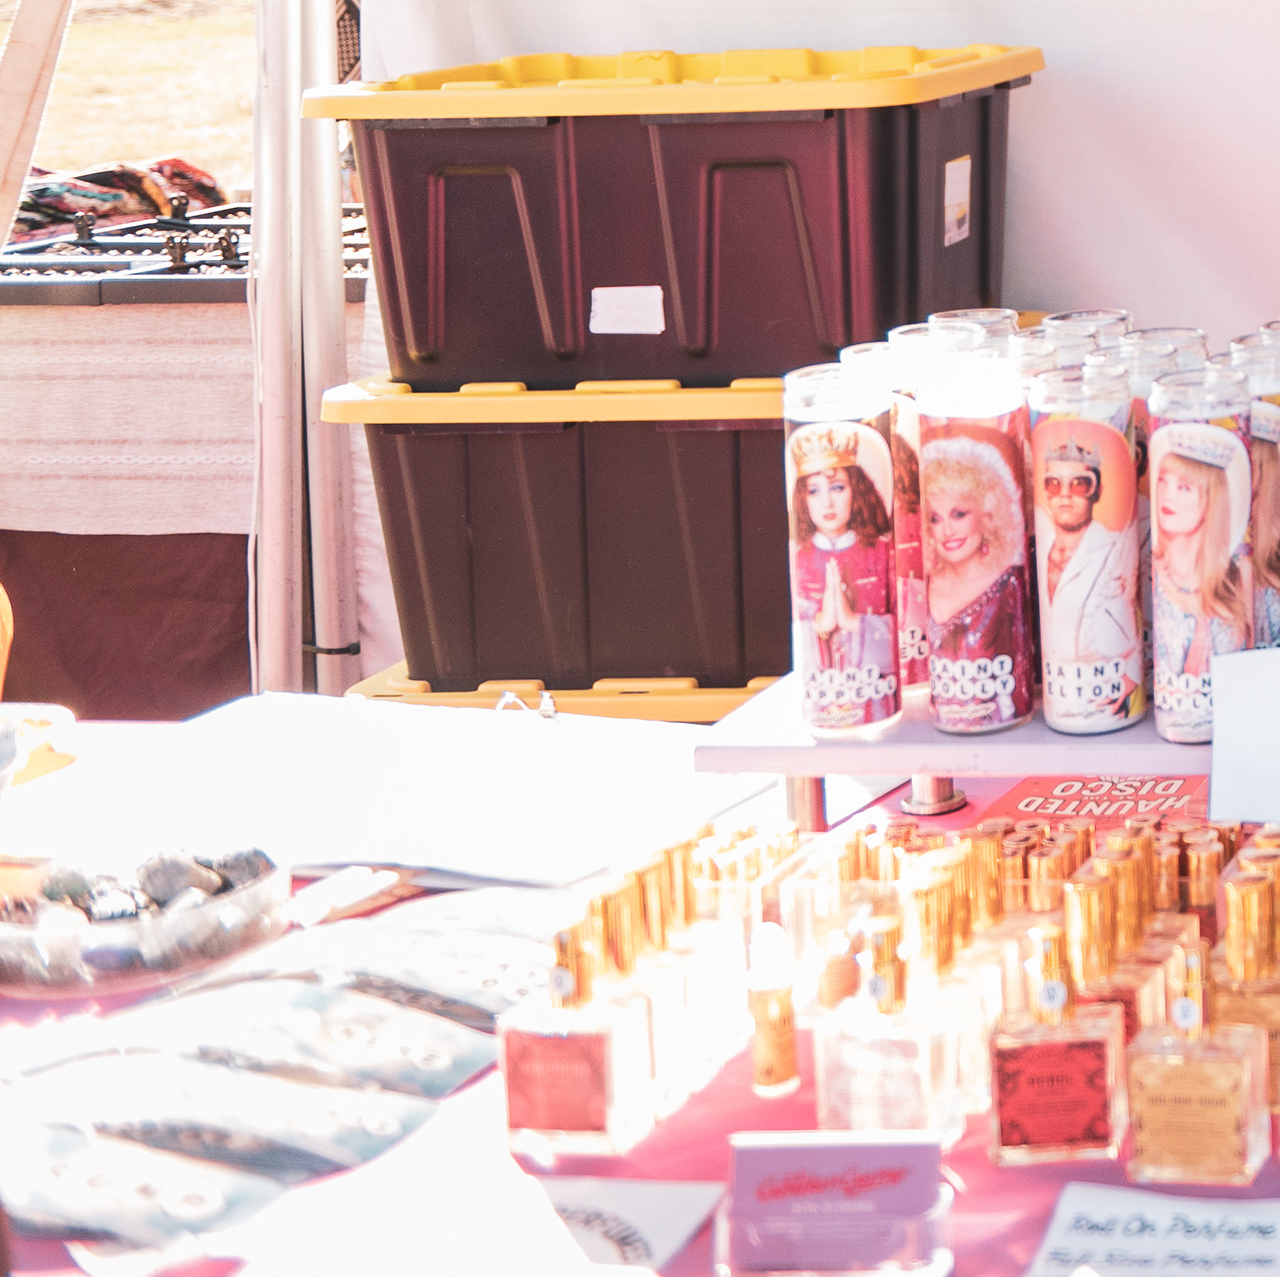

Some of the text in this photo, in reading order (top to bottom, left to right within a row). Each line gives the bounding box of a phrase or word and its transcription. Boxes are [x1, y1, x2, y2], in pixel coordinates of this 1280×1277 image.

[930, 658, 1007, 674] SAINT
[1045, 662, 1121, 678] SAINT
[1047, 682, 1121, 697] ELTON
[1051, 779, 1186, 796] DISCO
[1016, 795, 1191, 816] HAUNTED
